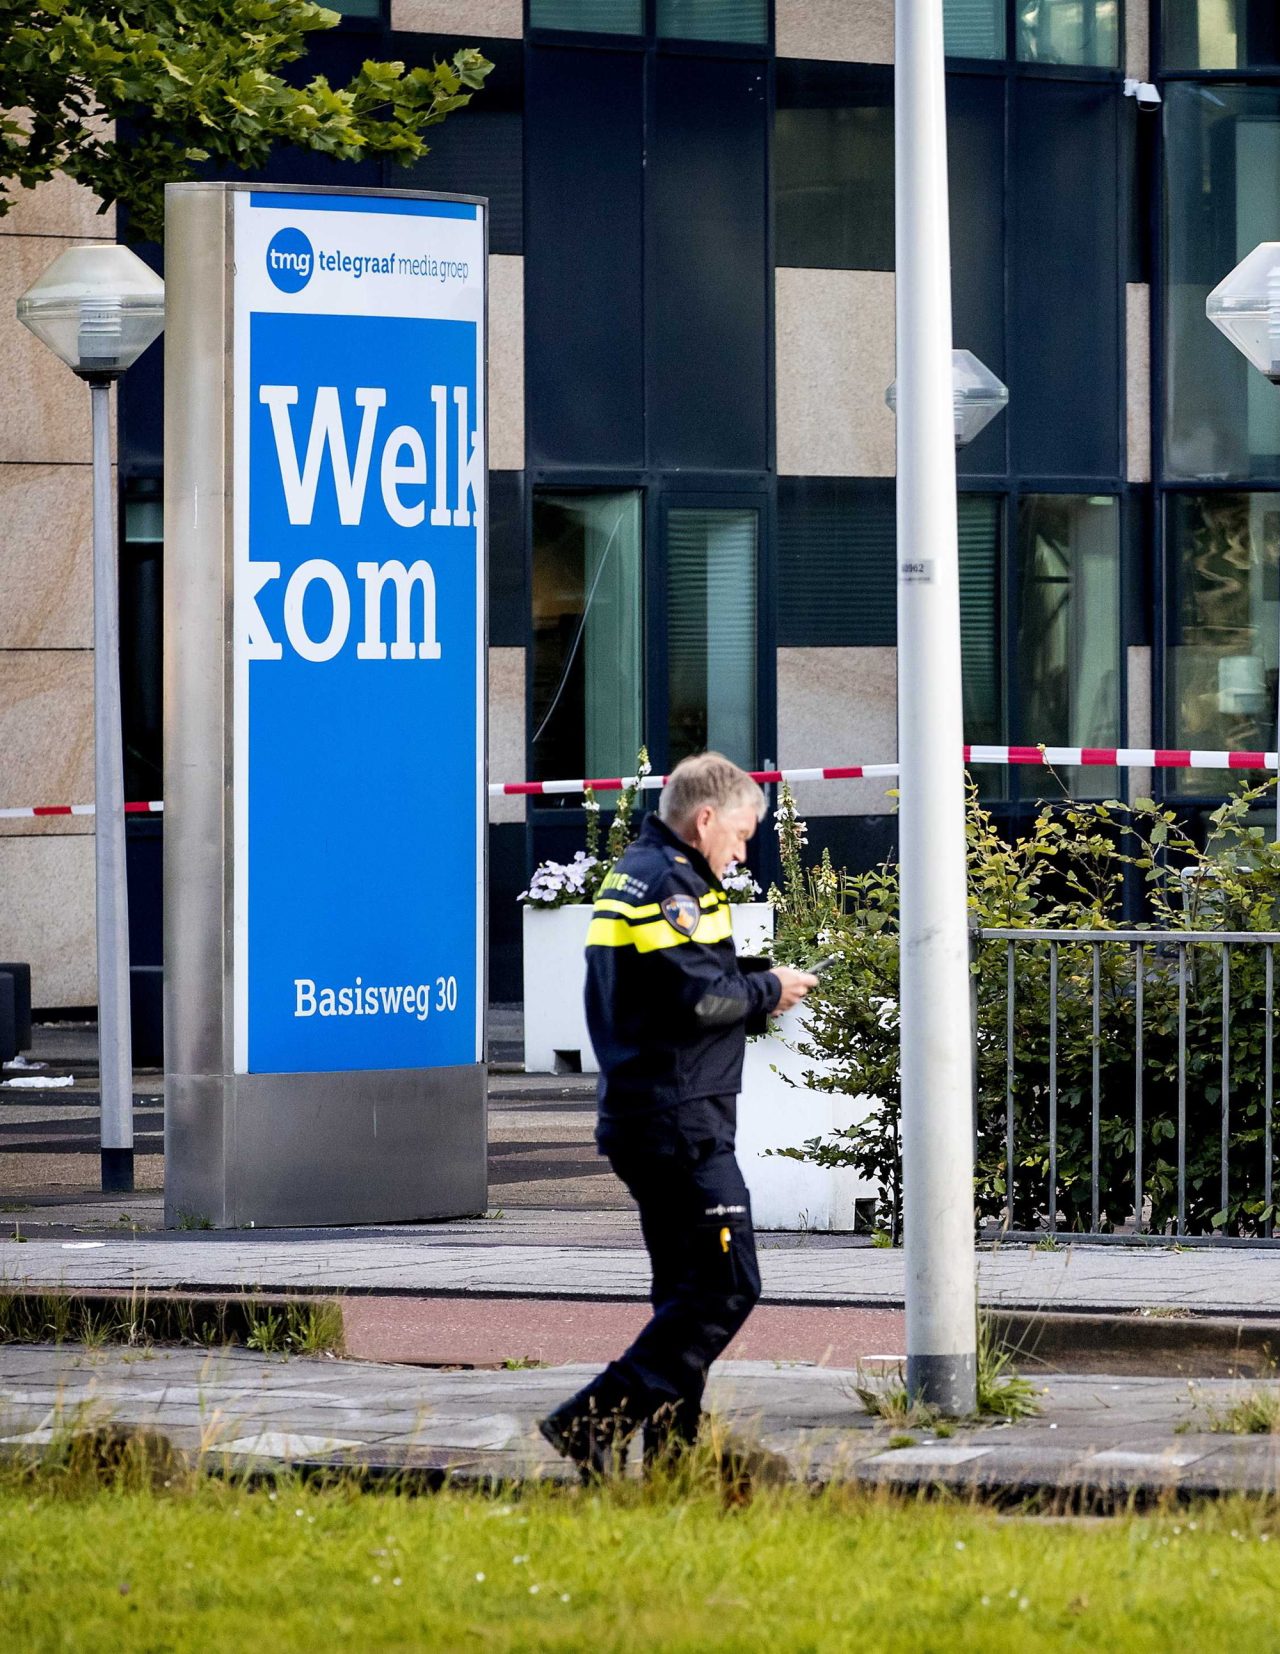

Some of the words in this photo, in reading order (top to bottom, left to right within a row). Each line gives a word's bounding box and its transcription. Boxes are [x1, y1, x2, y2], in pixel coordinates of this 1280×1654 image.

[270, 249, 311, 277] tmg
[319, 250, 396, 278] telegraaf
[294, 976, 430, 1021] Basisweg
[435, 975, 457, 1012] 30
